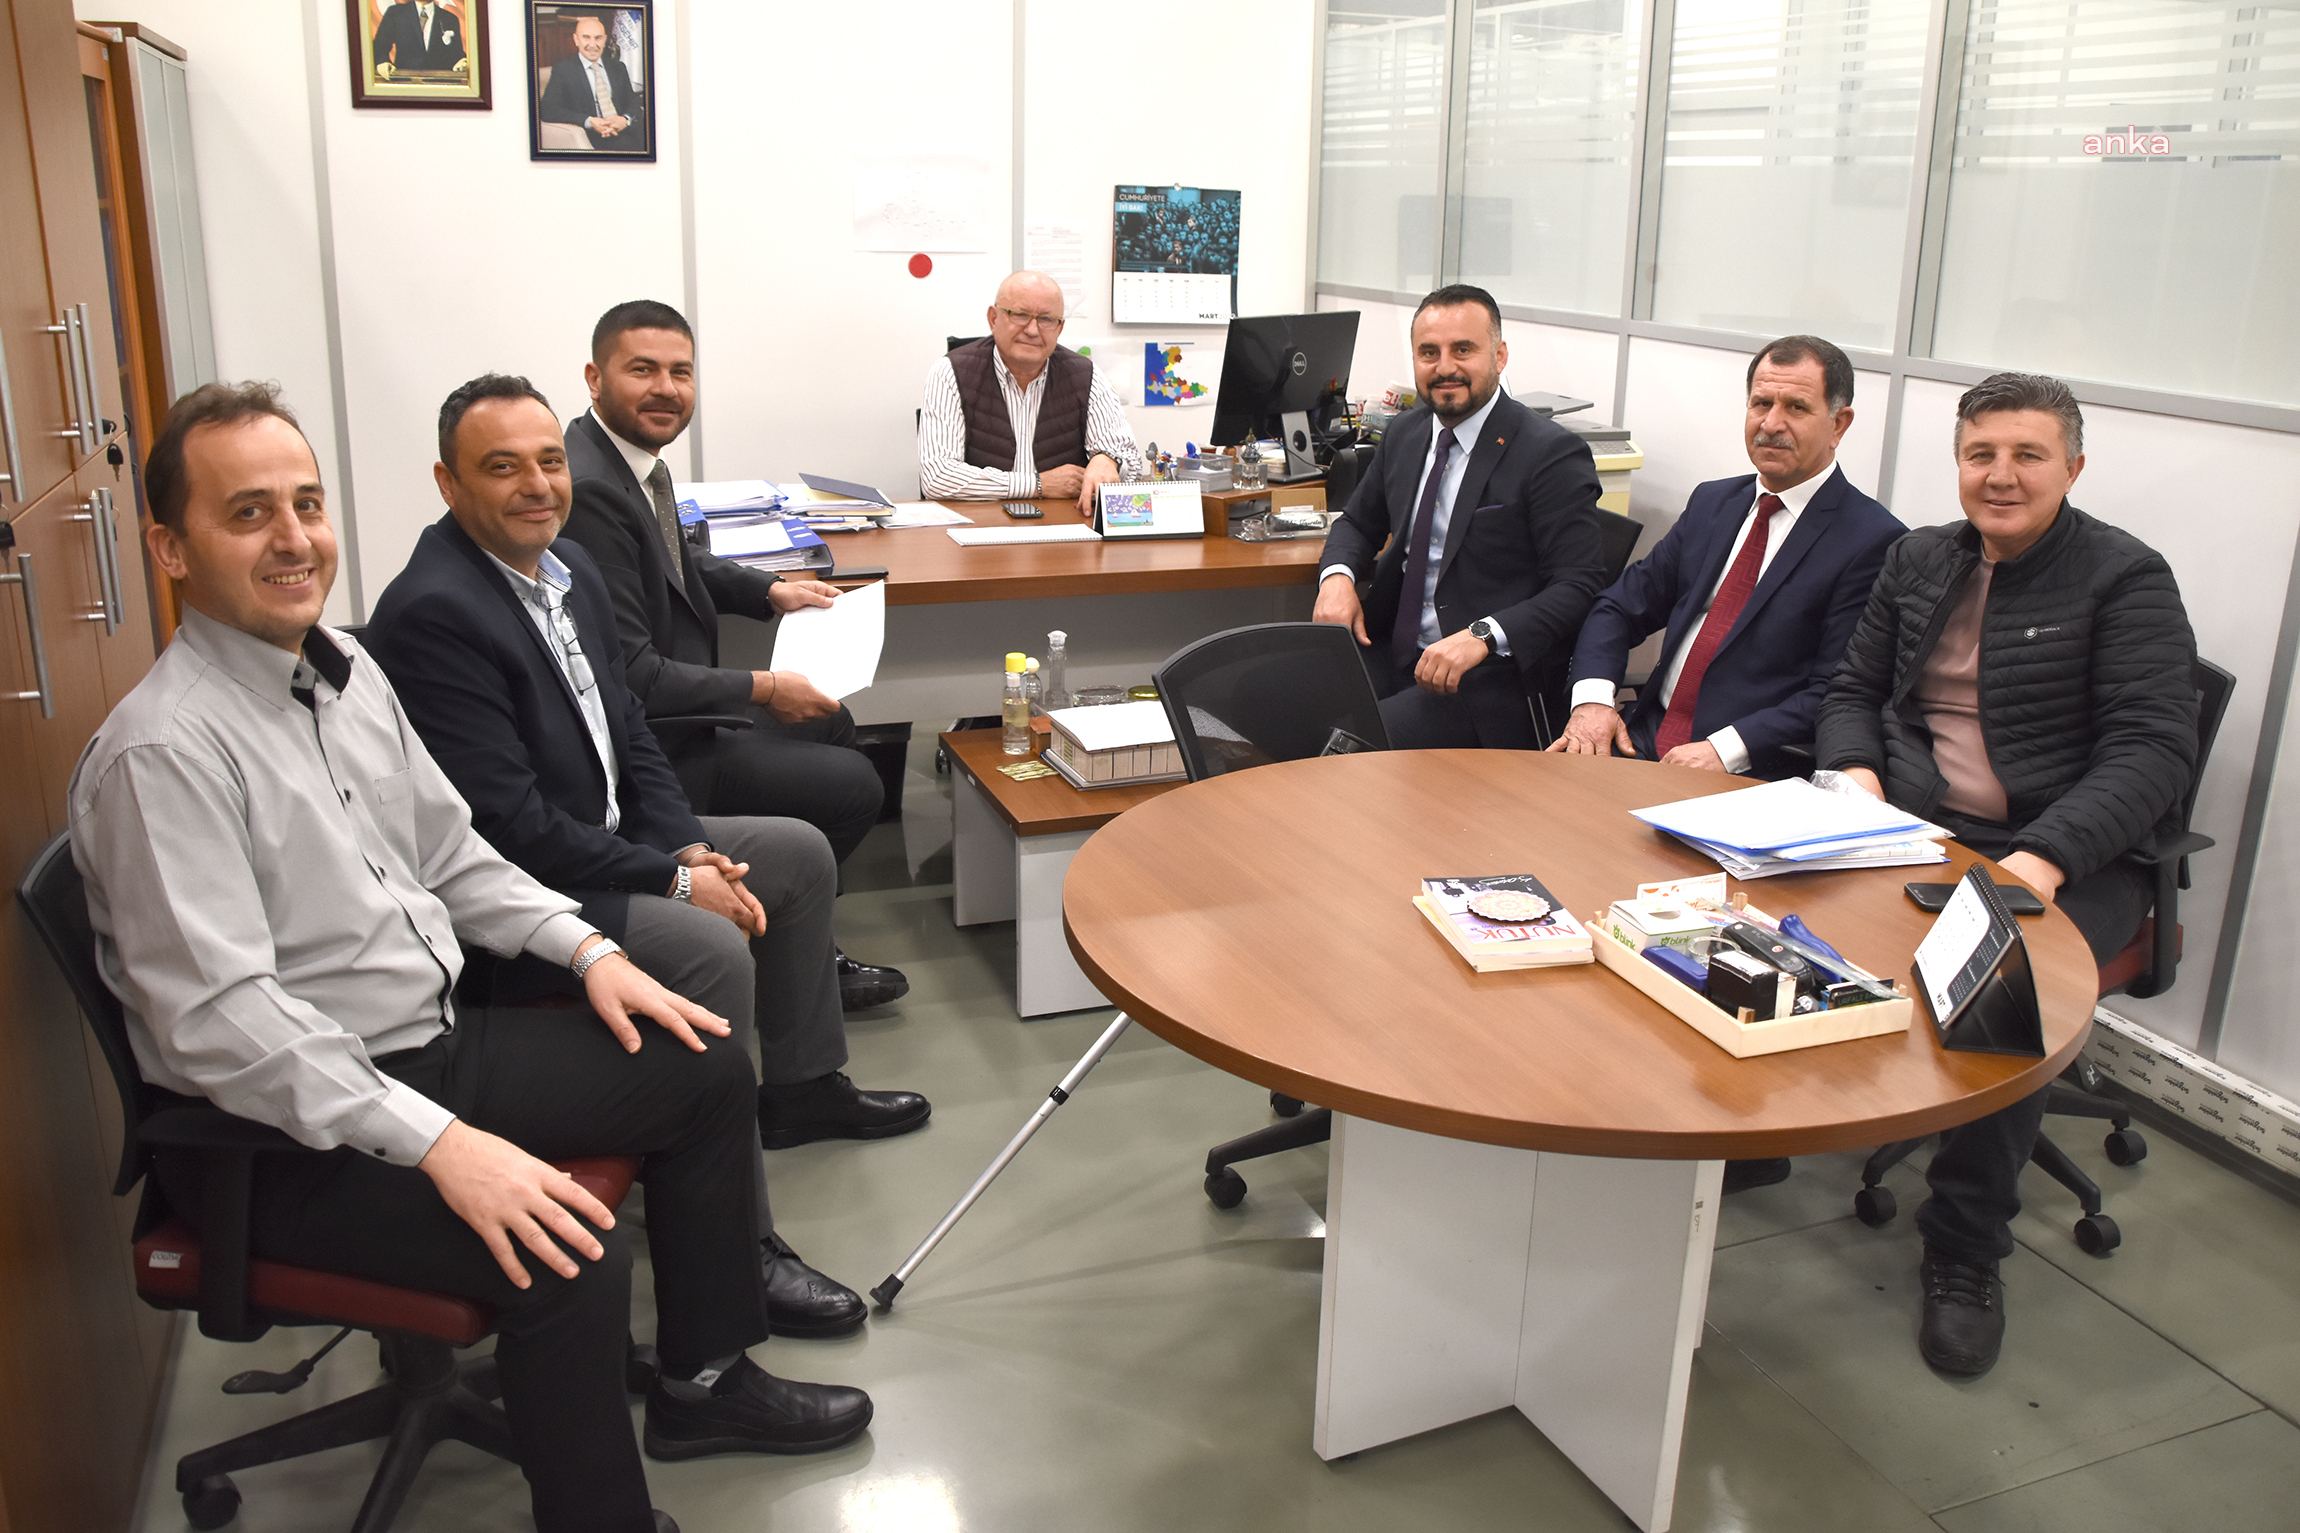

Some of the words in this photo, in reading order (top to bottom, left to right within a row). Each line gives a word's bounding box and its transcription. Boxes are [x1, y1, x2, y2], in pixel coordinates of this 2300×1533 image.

[1118, 193, 1166, 202] CUMHURİYETE
[1294, 360, 1306, 368] DELL
[1476, 923, 1577, 940] NUTUK
[1619, 931, 1636, 951] blink
[1669, 935, 1692, 947] blink
